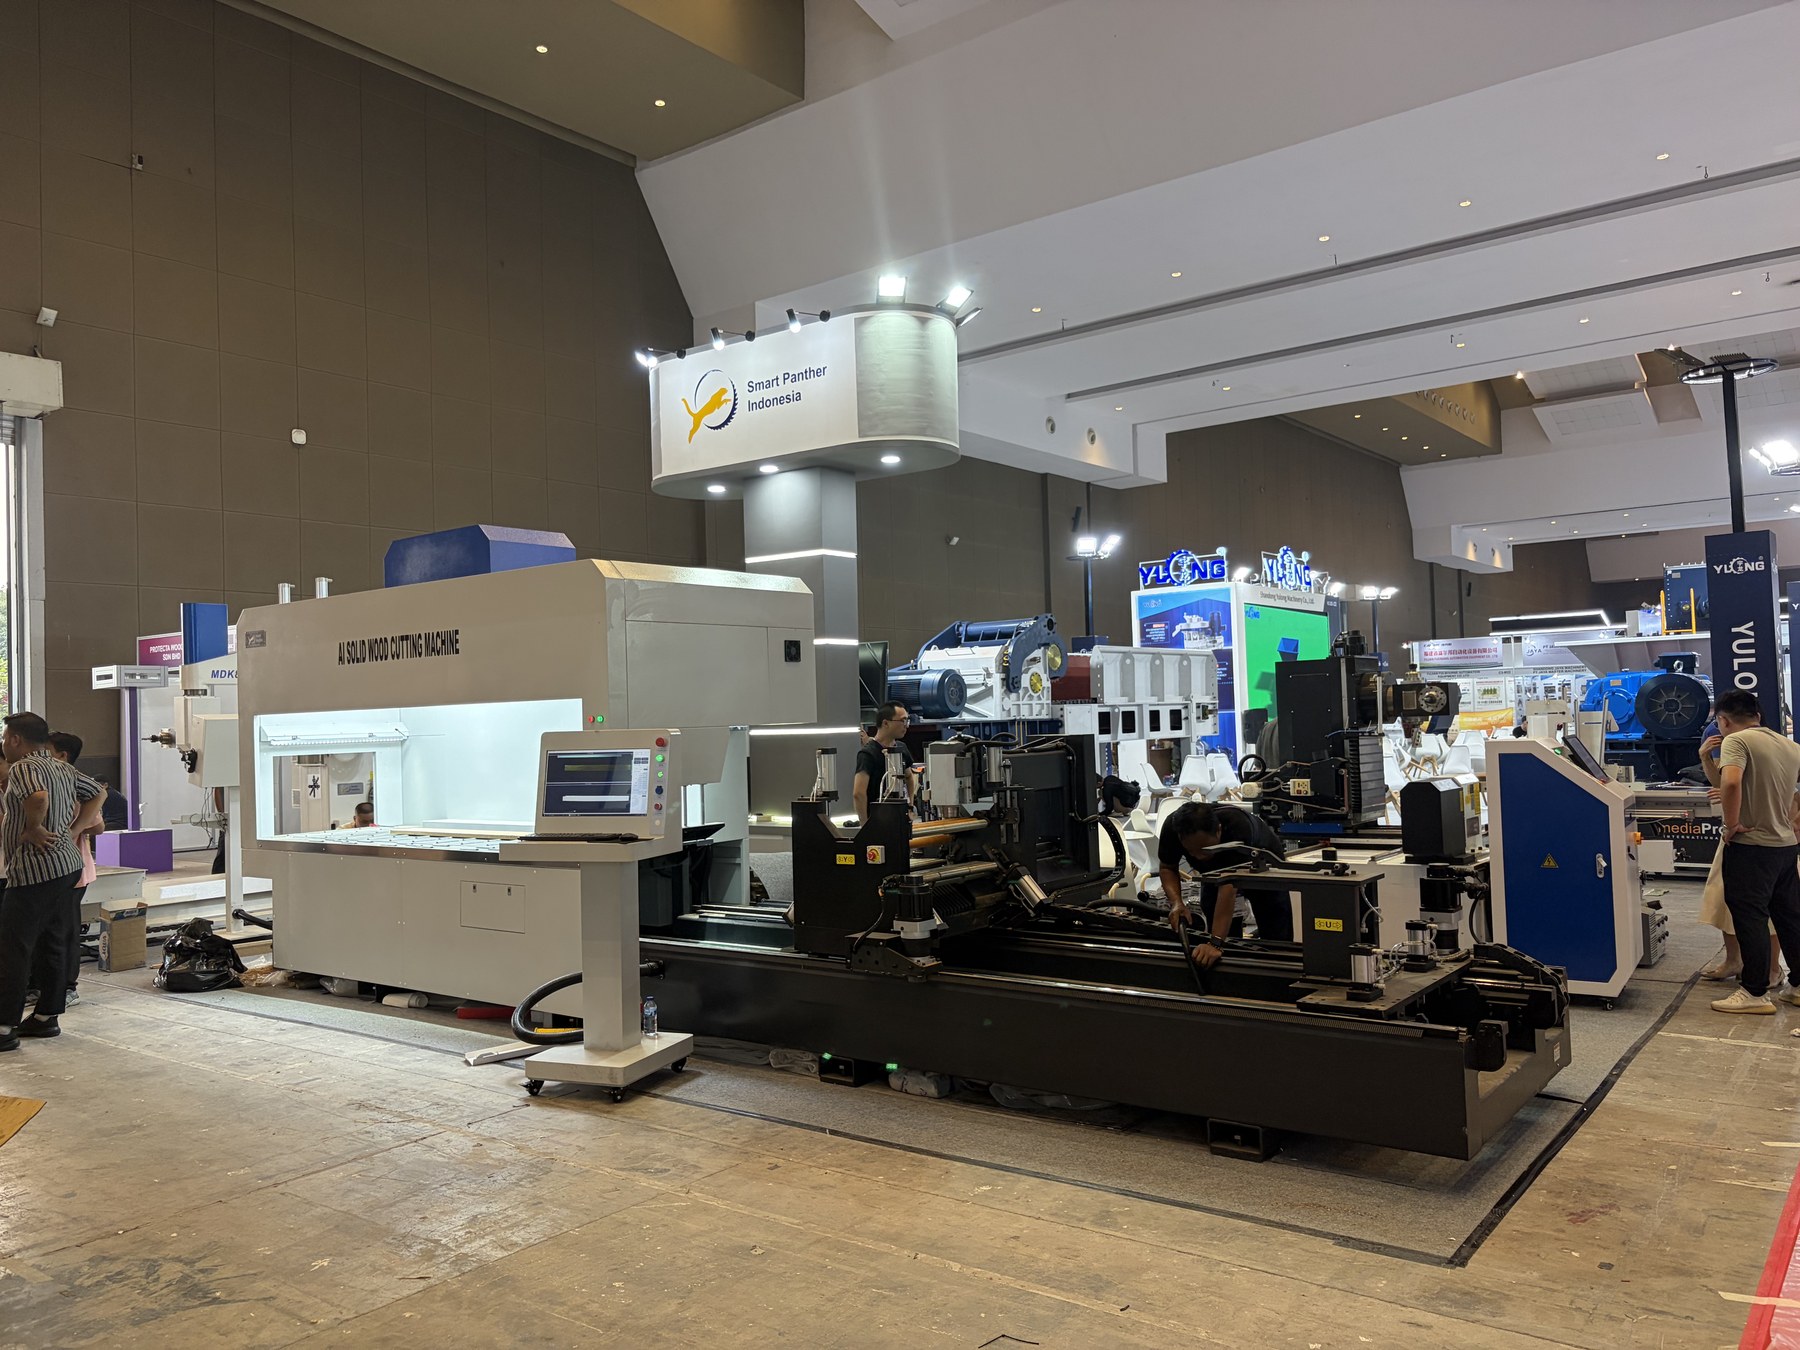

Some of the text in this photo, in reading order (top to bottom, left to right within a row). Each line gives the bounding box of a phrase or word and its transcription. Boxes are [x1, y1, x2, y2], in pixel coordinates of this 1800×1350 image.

[747, 366, 828, 393] Smart Panther
[748, 390, 802, 412] Indonesia
[149, 644, 170, 653] PROTECTA
[338, 629, 460, 665] AI SOLID WOOD CUTTING MACHINE
[1731, 621, 1758, 698] YULO
